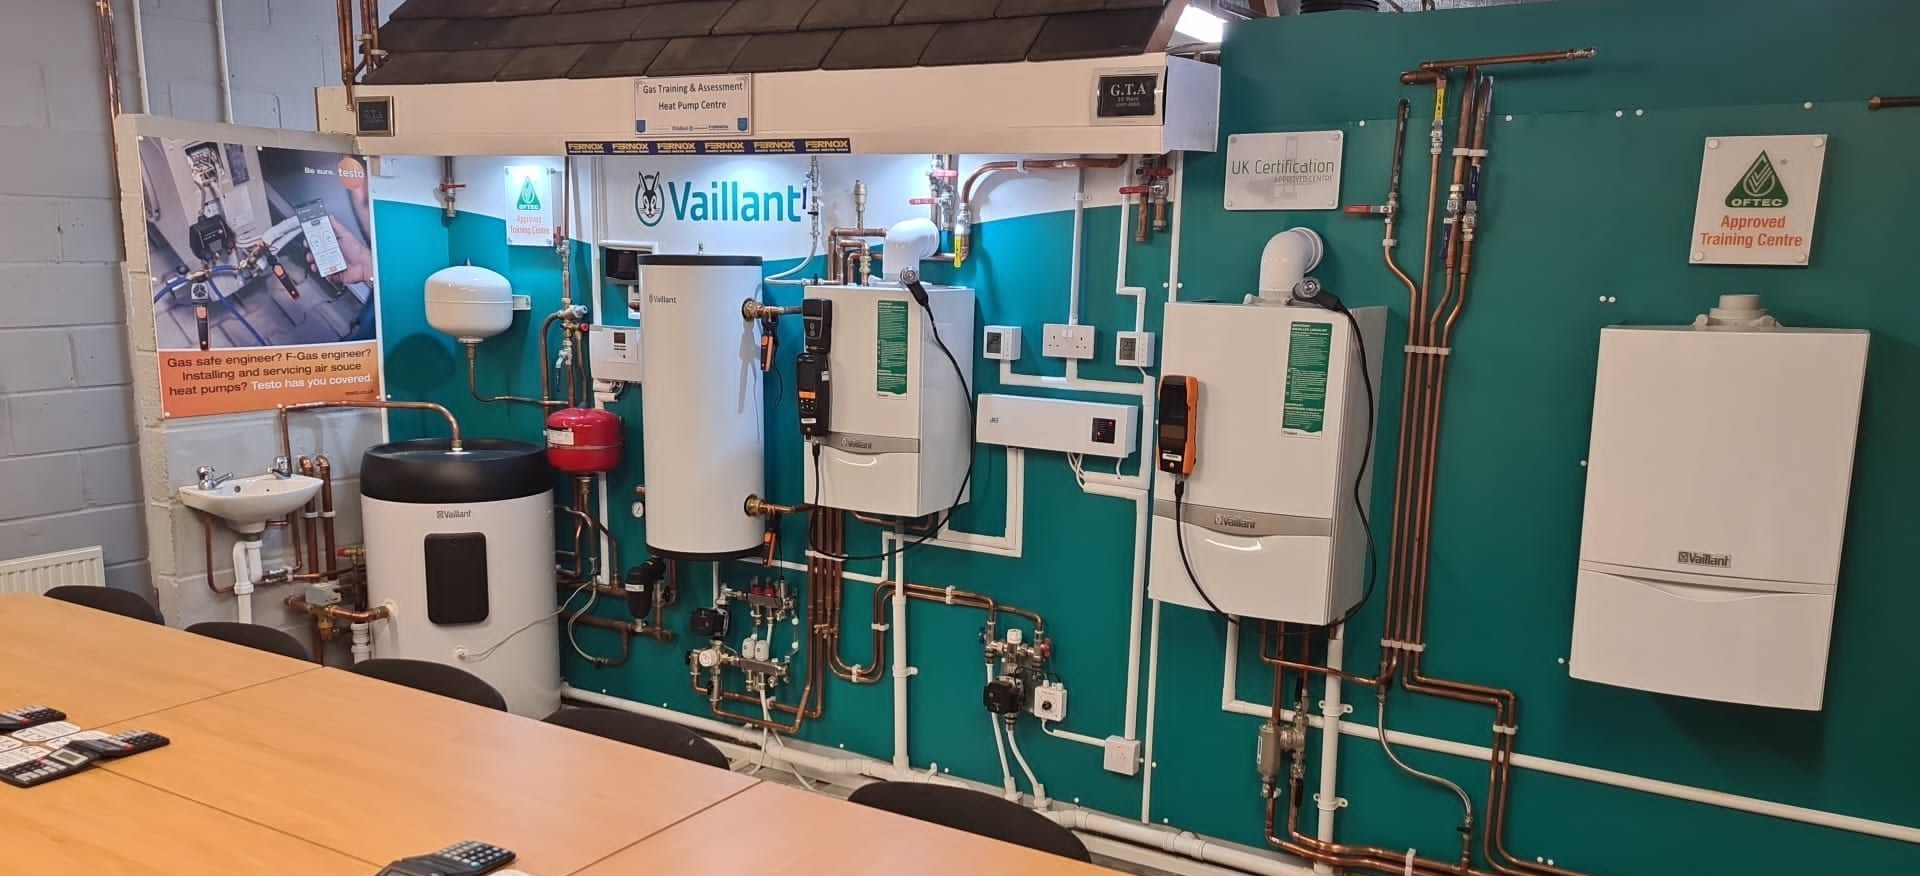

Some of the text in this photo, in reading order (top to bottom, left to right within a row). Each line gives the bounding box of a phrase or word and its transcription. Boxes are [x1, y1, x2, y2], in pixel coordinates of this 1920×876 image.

[642, 82, 743, 95] Gas Training & Assessment
[1111, 83, 1146, 96] G.T.A
[658, 100, 727, 111] Heat Pump Centre
[657, 142, 696, 150] FERNOX
[704, 141, 745, 149] FERNOX
[753, 140, 796, 148] FERNOX
[804, 140, 849, 148] FERNOX
[303, 166, 315, 174] Be
[338, 167, 365, 178] testo
[1231, 158, 1335, 175] UK Certification
[667, 180, 803, 222] Vaillant
[1731, 198, 1784, 207] OFTEC
[1720, 214, 1786, 231] Approved
[1700, 232, 1803, 248] Training Centre
[653, 295, 677, 304] Vaillant
[167, 349, 372, 368] Gas safe engineer? F-Gas engineer?
[182, 362, 362, 382] Installing and servicing air souce
[169, 385, 197, 396] heat
[200, 381, 248, 396] pumps?
[251, 380, 281, 391] Testo
[284, 377, 305, 388] has
[307, 376, 327, 389] you
[444, 509, 472, 519] Vaillant
[1689, 552, 1729, 567] Vaillant
